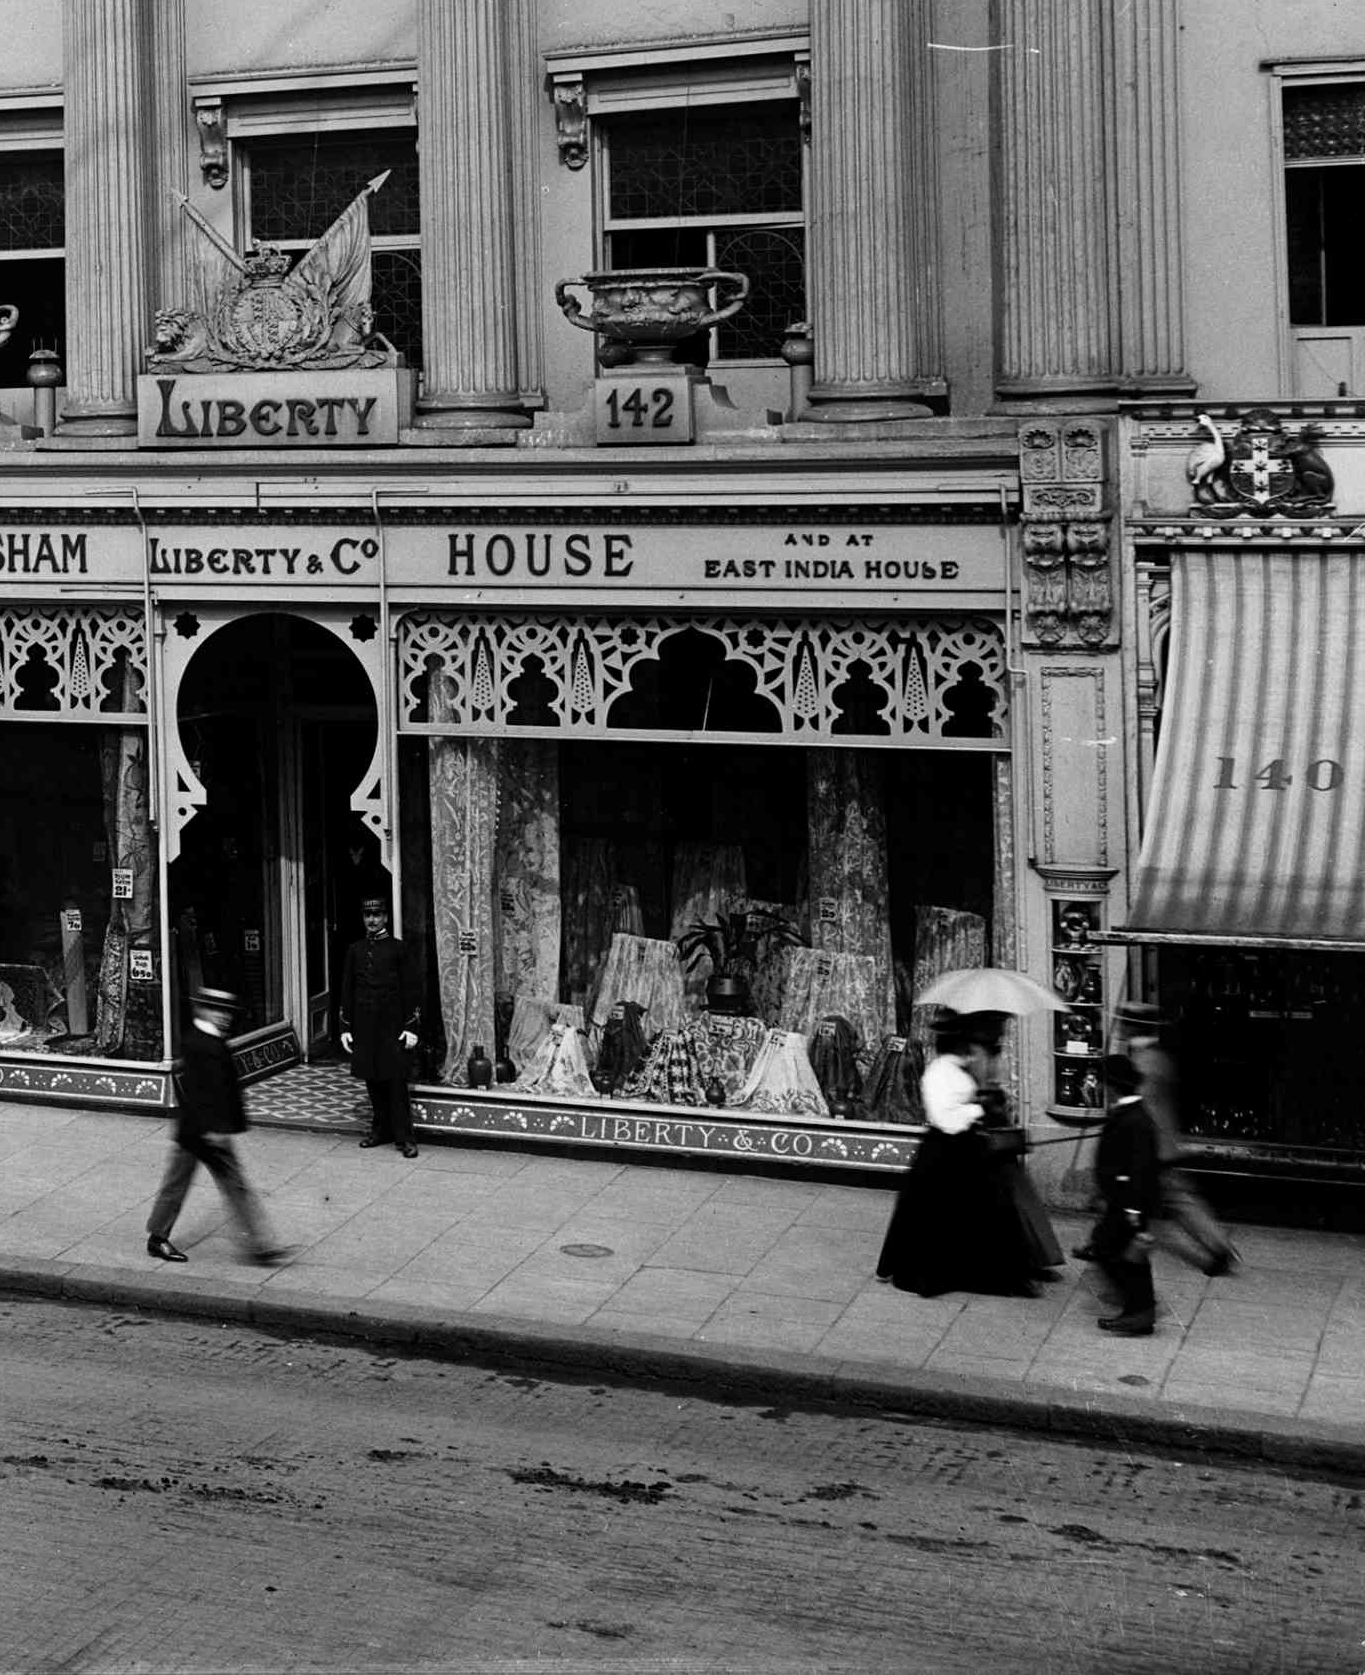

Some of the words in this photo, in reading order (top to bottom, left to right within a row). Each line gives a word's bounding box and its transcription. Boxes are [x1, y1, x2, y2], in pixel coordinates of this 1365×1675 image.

[155, 379, 378, 438] LIBERTY
[606, 388, 674, 429] 142
[149, 536, 302, 575] LIBERTY
[306, 552, 324, 575] &
[447, 532, 635, 578] HOUSE
[784, 533, 830, 546] AND
[845, 534, 873, 546] AT
[704, 559, 776, 579] EAST
[784, 559, 855, 580] INDIA
[864, 560, 960, 580] HOUSE
[1212, 755, 1345, 792] 140
[581, 1115, 717, 1149] LIBERTY
[732, 1128, 758, 1152] &
[770, 1132, 814, 1156] CO
